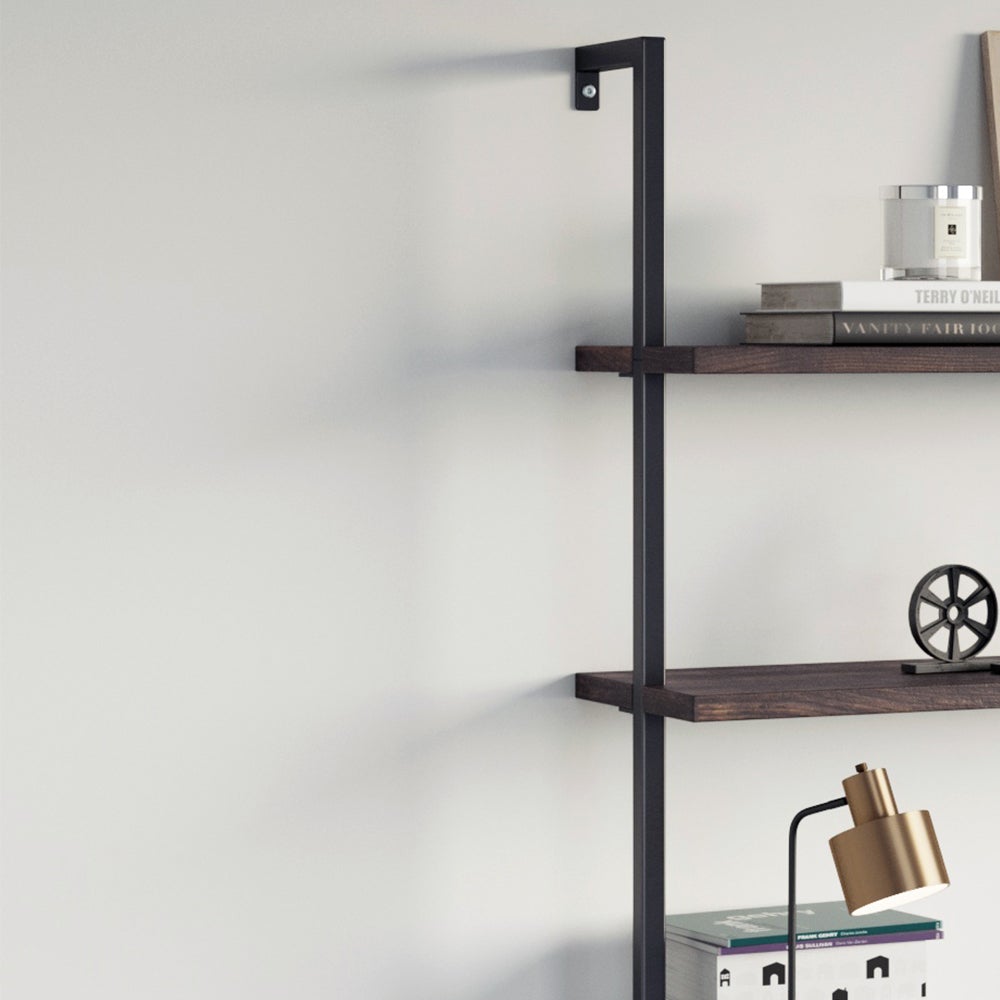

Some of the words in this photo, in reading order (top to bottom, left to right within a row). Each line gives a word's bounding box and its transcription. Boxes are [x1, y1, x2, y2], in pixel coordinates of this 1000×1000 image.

[914, 288, 958, 305] TERRY
[842, 321, 914, 335] VANITY
[920, 321, 964, 335] FAIR
